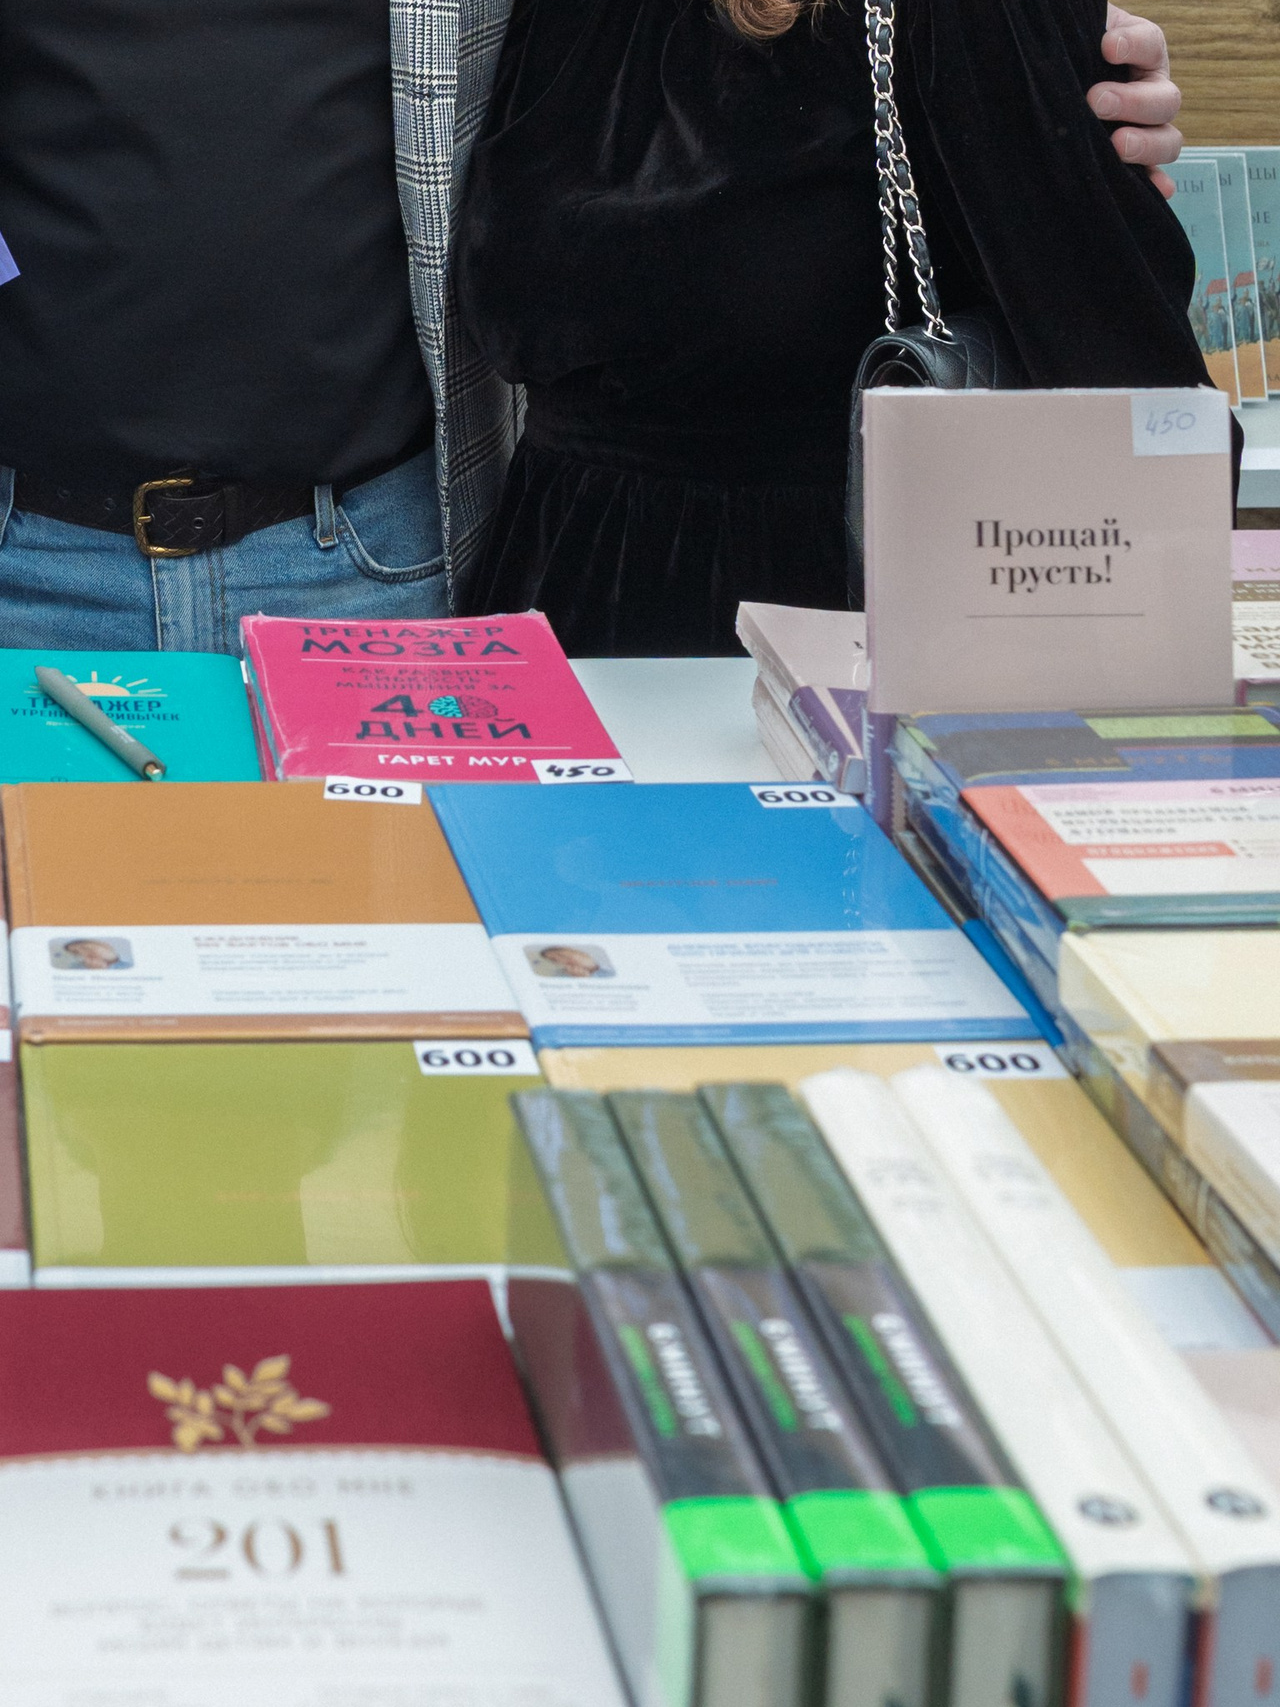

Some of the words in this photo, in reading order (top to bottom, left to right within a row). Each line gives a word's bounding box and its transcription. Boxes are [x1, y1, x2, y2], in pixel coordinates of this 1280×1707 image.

[1144, 410, 1196, 436] 450
[972, 518, 1132, 556] Прощай,
[989, 553, 1112, 594] грусть!
[298, 626, 504, 638] ТРЕНАЖЕР
[301, 640, 521, 657] МОЗГА
[27, 696, 162, 712] ТРАЖЕР
[108, 712, 180, 721] РИВЫЧЕК
[355, 719, 532, 740] ДНЕЙ
[377, 754, 455, 766] ГАРЕТ
[468, 755, 528, 766] МУР
[546, 763, 616, 777] 450
[327, 783, 404, 798] 600
[758, 789, 836, 804] 600
[421, 1049, 518, 1068] 600
[944, 1053, 1041, 1072] 600
[168, 1516, 349, 1582] 201
